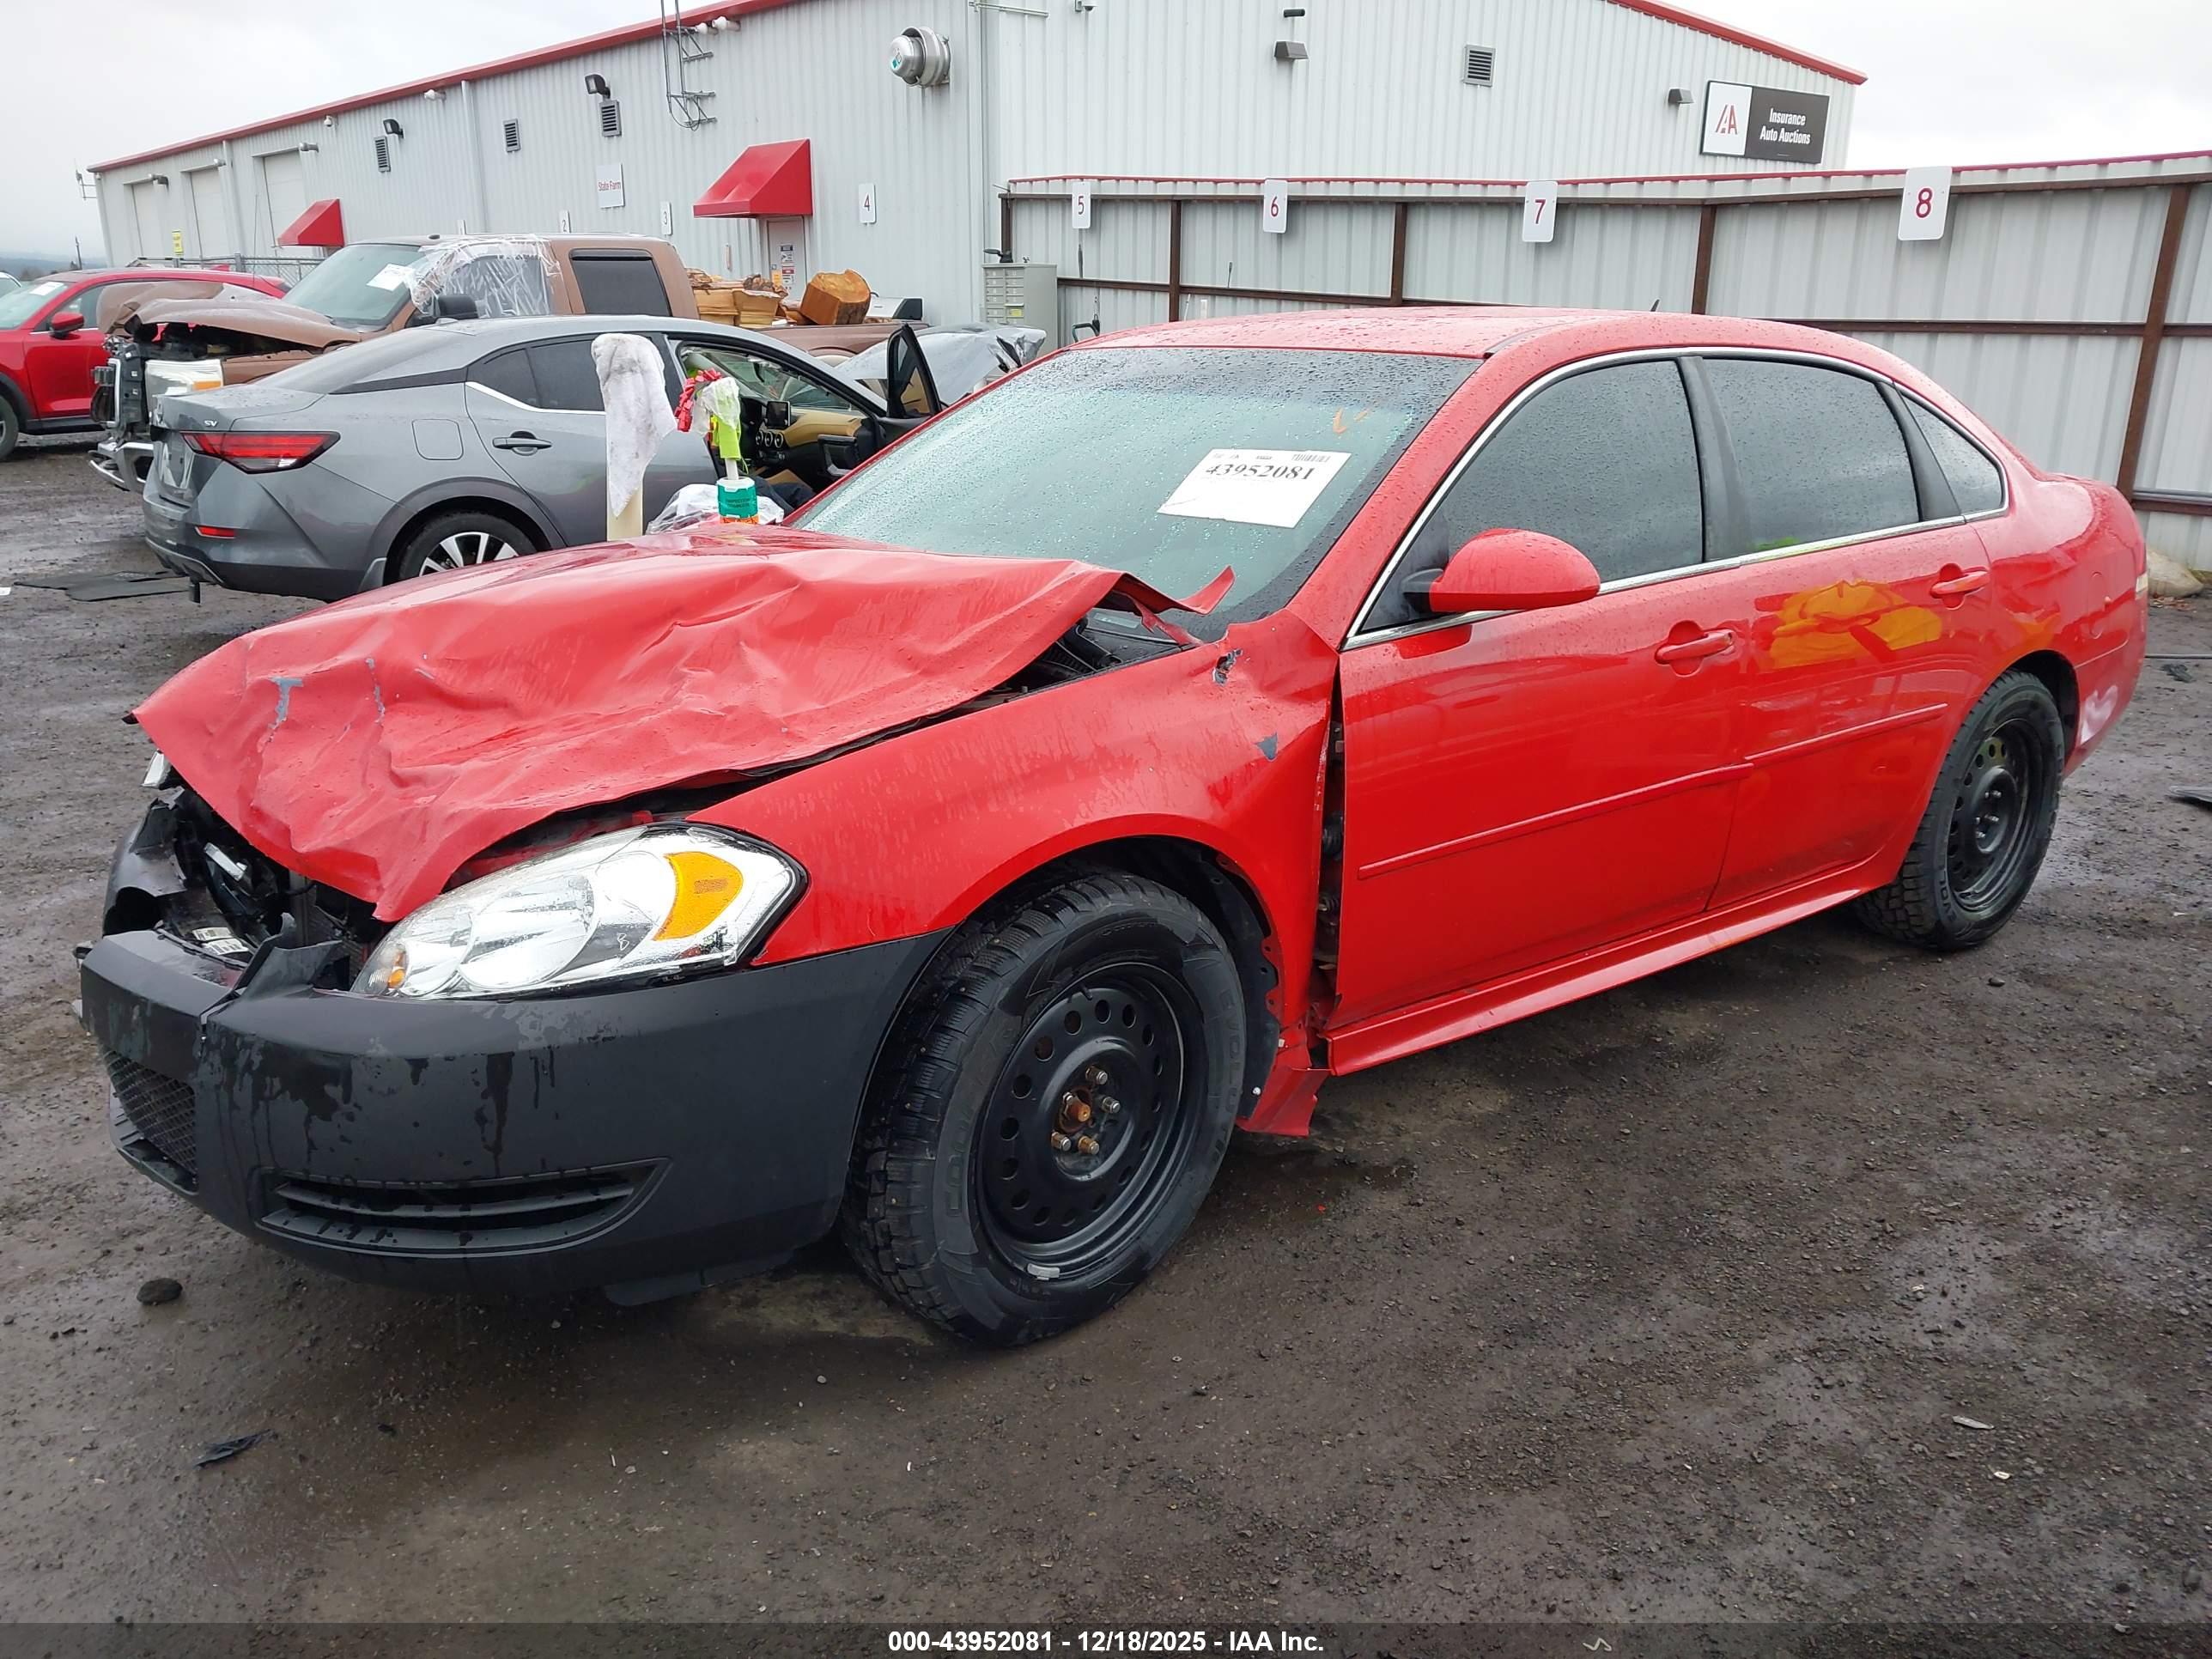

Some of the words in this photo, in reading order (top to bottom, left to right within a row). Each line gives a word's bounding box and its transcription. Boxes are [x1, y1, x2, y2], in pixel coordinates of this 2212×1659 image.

[1769, 107, 1806, 126] Insurance
[1759, 125, 1778, 142] Auto
[1778, 127, 1811, 144] Auctions
[863, 194, 871, 211] 4
[1078, 195, 1085, 215] 5
[1270, 196, 1279, 217] 6
[1534, 198, 1547, 224] 7
[1916, 187, 1933, 219] 8
[562, 219, 568, 233] 2
[662, 211, 669, 226] 3
[1205, 463, 1316, 480] 43952081
